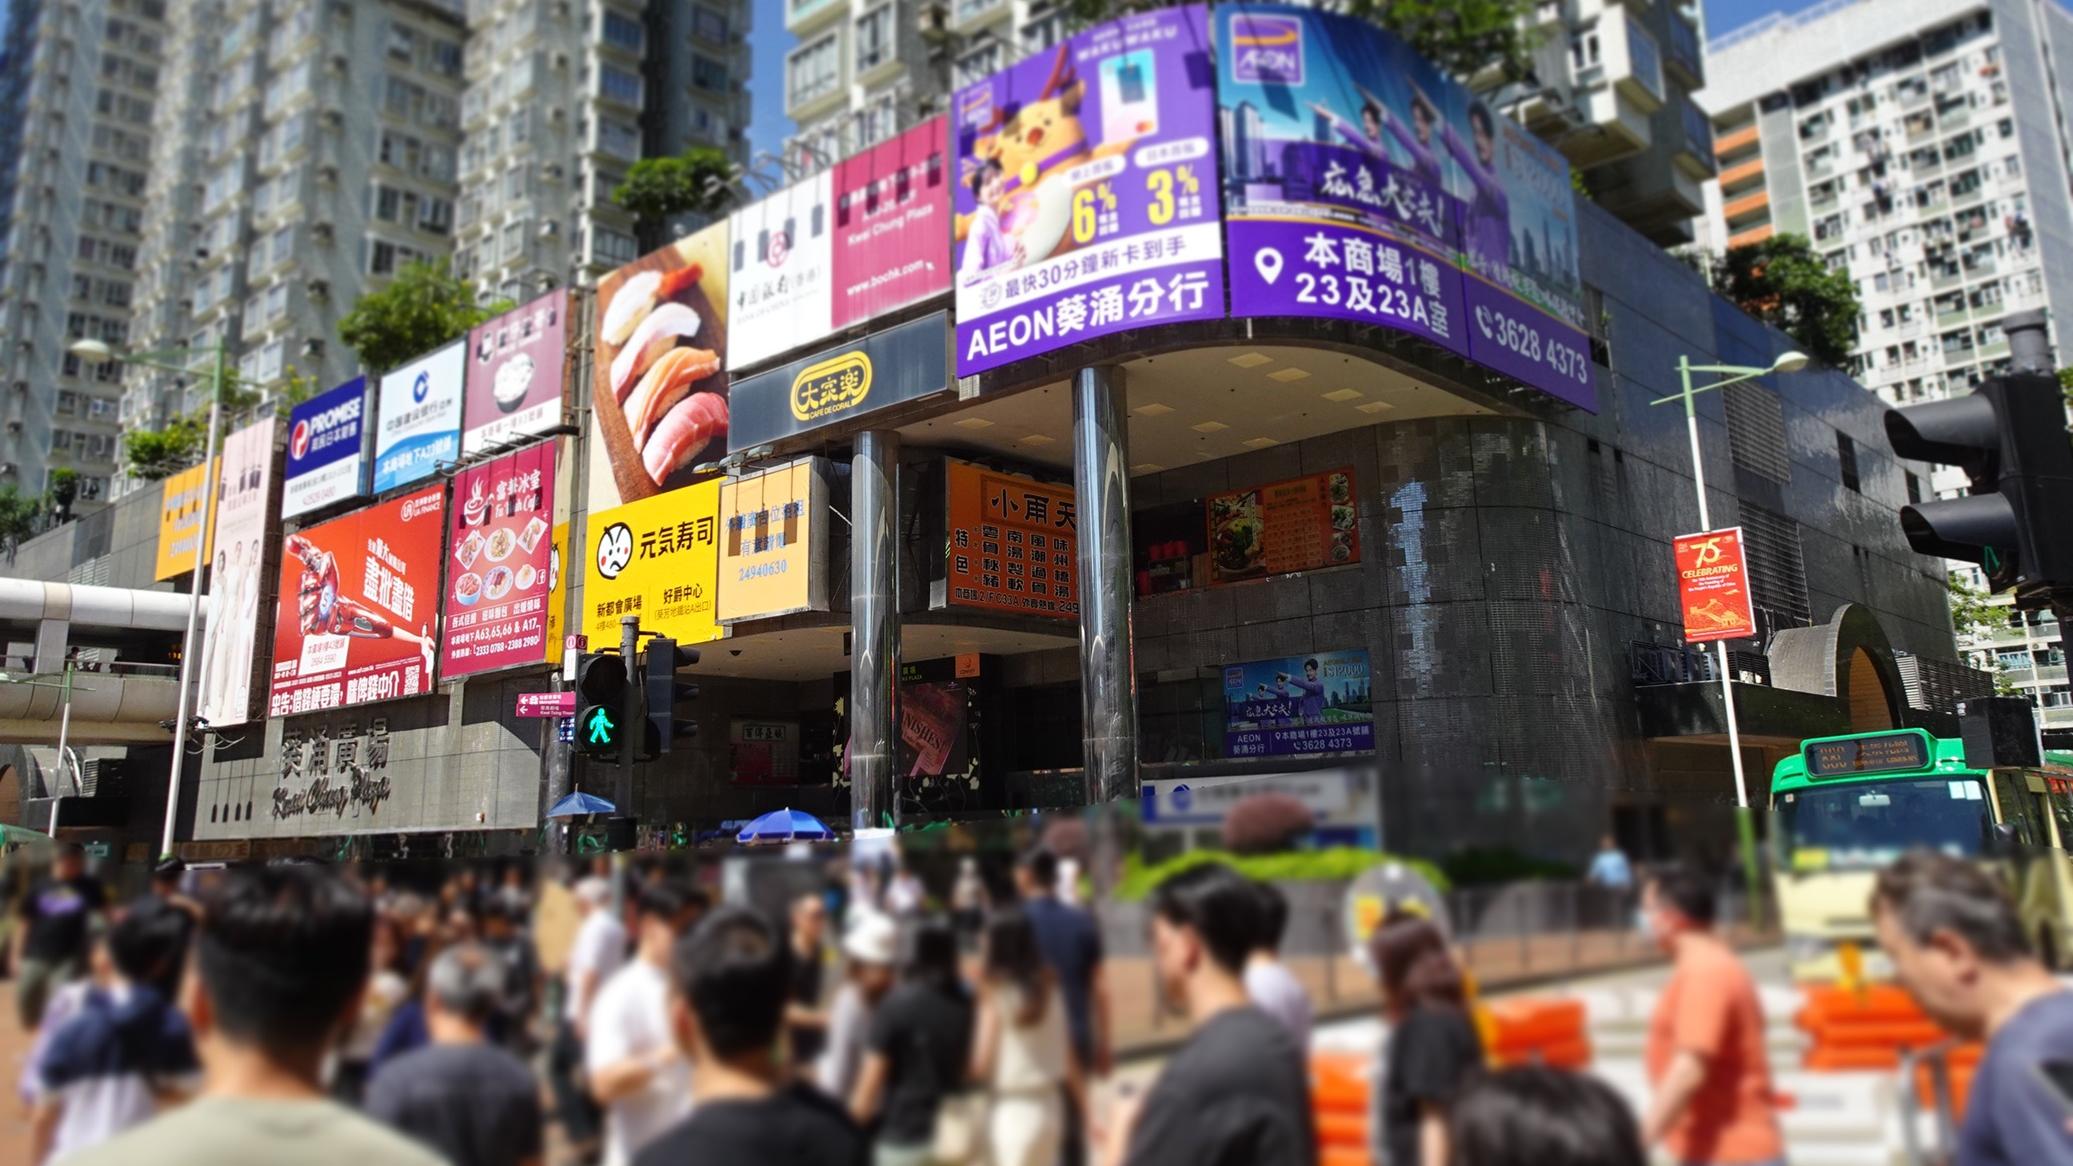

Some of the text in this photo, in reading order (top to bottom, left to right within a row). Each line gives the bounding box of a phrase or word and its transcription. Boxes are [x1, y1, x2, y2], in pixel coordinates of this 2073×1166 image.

[1005, 236, 1186, 299] 最快30分鐘新卡到手
[1304, 232, 1440, 299] 本商場1樓
[967, 271, 1209, 360] AEON葵涌分行
[1295, 273, 1449, 338] 23及23A室
[1494, 314, 1588, 385] 3628 4373
[310, 397, 362, 436] PROMISE
[640, 516, 714, 560] 元気寿司
[1690, 537, 1720, 568] 75
[739, 560, 787, 581] 24940630
[1682, 563, 1738, 578] CELEBRATING
[514, 621, 520, 633] &
[282, 717, 390, 778] 葵涌廣場
[1237, 734, 1261, 744] AEON
[1302, 738, 1352, 750] 3628 4373
